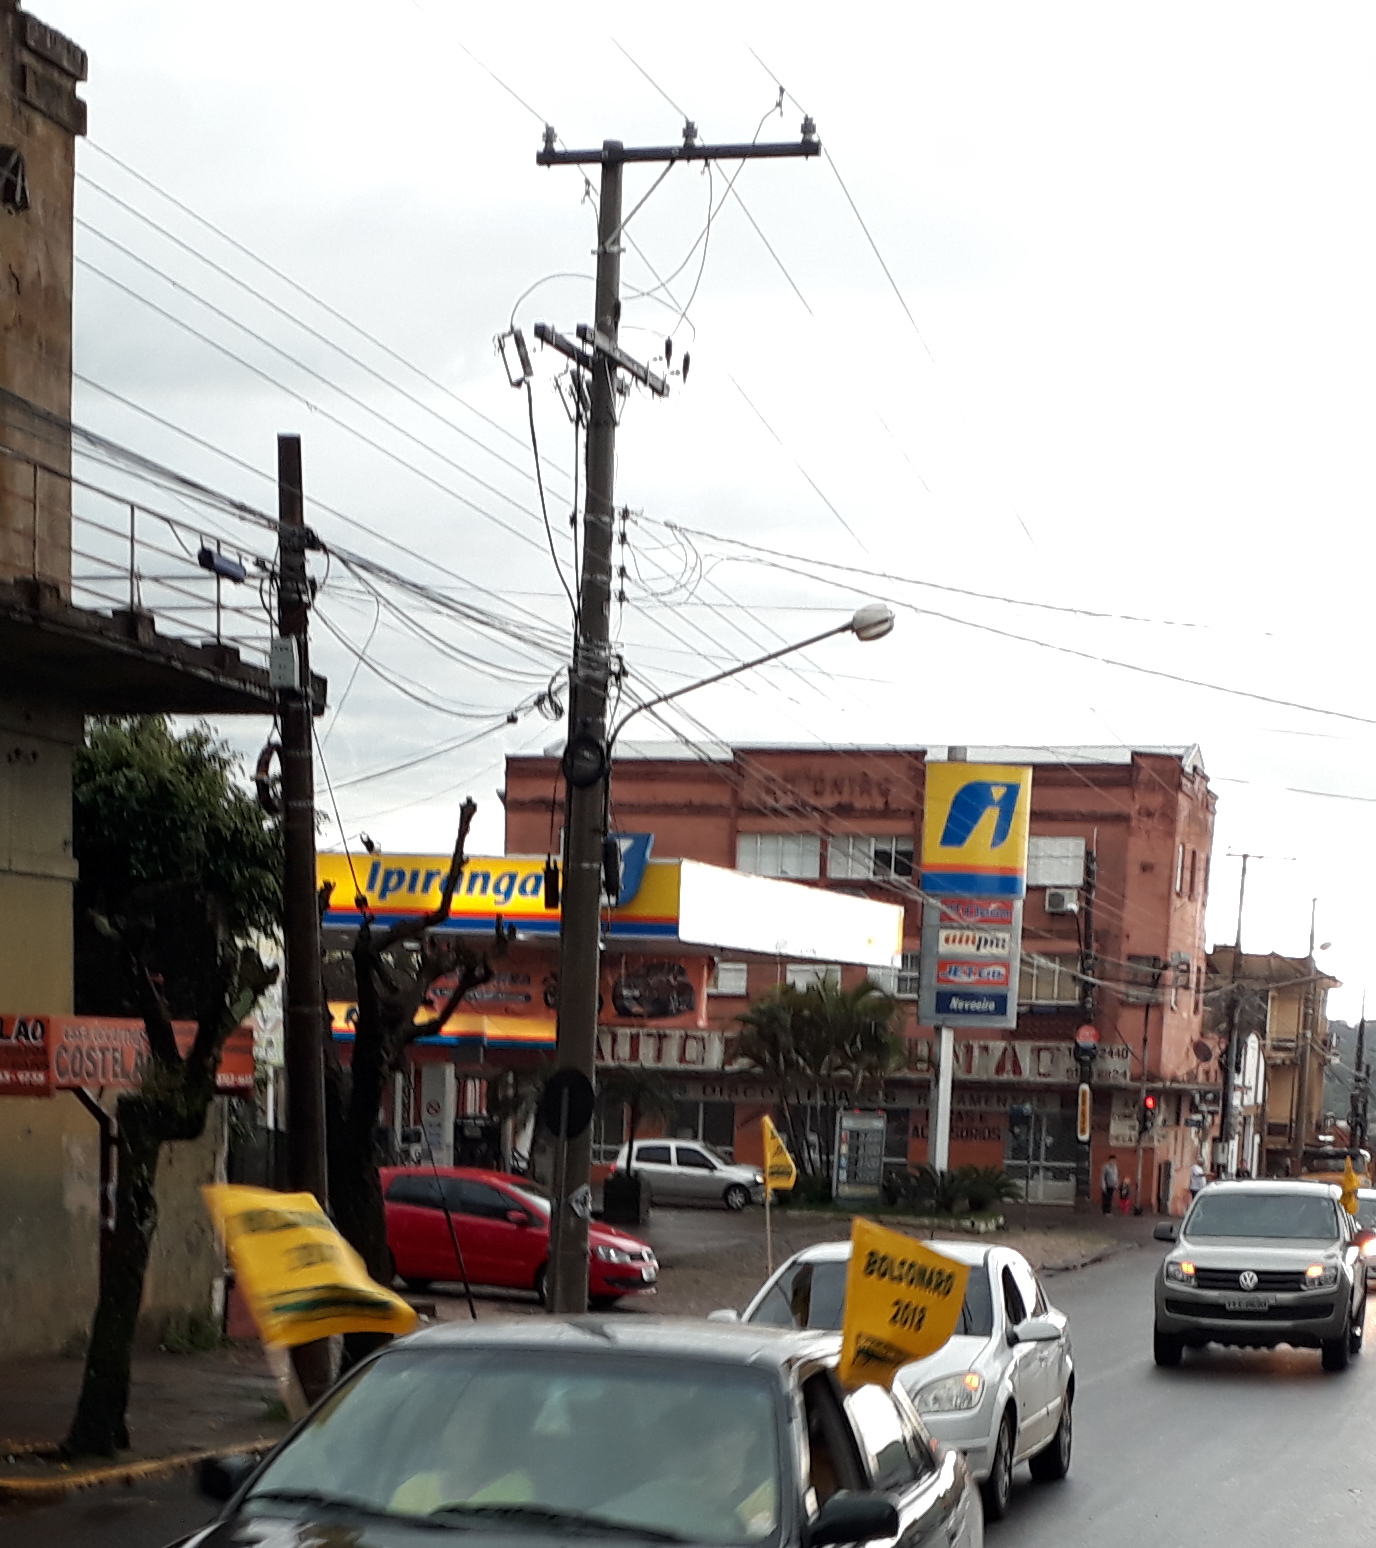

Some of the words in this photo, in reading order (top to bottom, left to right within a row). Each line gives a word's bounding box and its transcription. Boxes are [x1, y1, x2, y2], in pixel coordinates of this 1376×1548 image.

[365, 861, 545, 906] Ipiranga
[944, 933, 1007, 952] ampm
[54, 1044, 146, 1085] COSTELA
[864, 1249, 956, 1299] BOLSONARO
[889, 1298, 928, 1333] 2018
